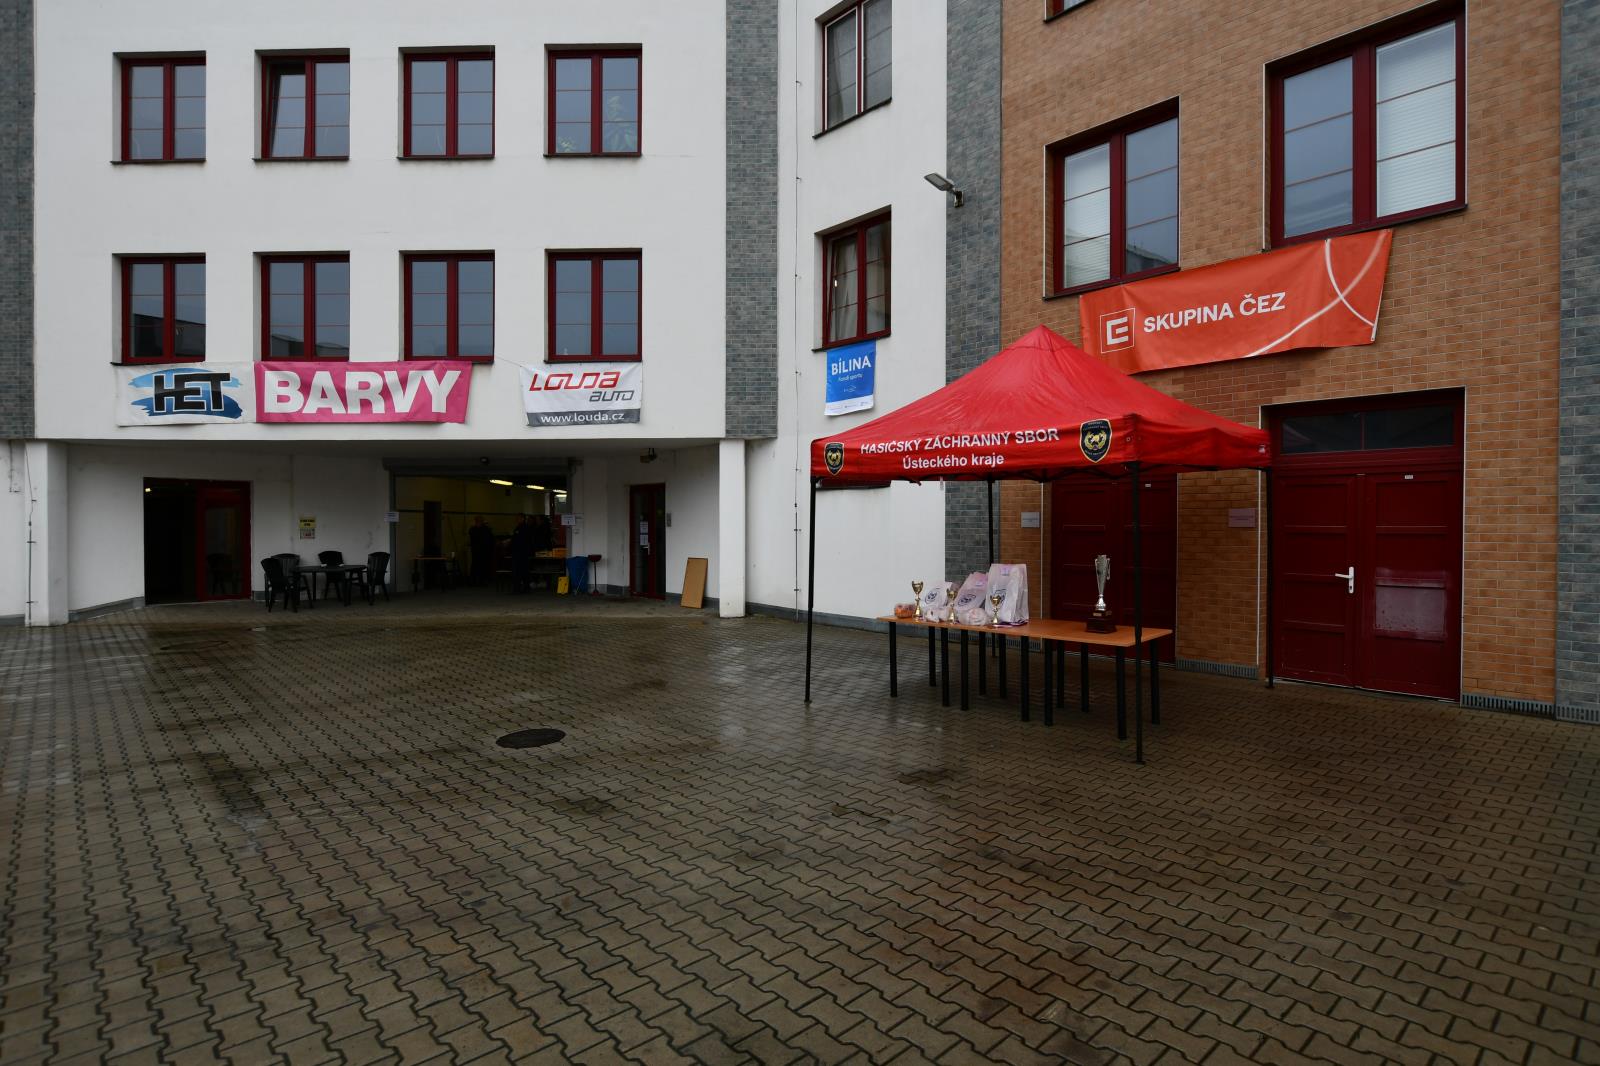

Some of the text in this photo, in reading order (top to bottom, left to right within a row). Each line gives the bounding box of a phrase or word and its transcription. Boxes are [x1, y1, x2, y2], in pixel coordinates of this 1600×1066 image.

[1143, 302, 1234, 333] SKUPINA
[1239, 292, 1286, 316] ČEZ
[832, 356, 872, 375] BÍLINA
[153, 372, 231, 413] HET
[263, 370, 462, 414] BARVY
[541, 412, 625, 423] www.louda.cz
[924, 430, 1010, 450] ZÁCHRANNÝ
[1014, 428, 1060, 444] SBOR
[902, 452, 1005, 470] Ústeckého kraje
